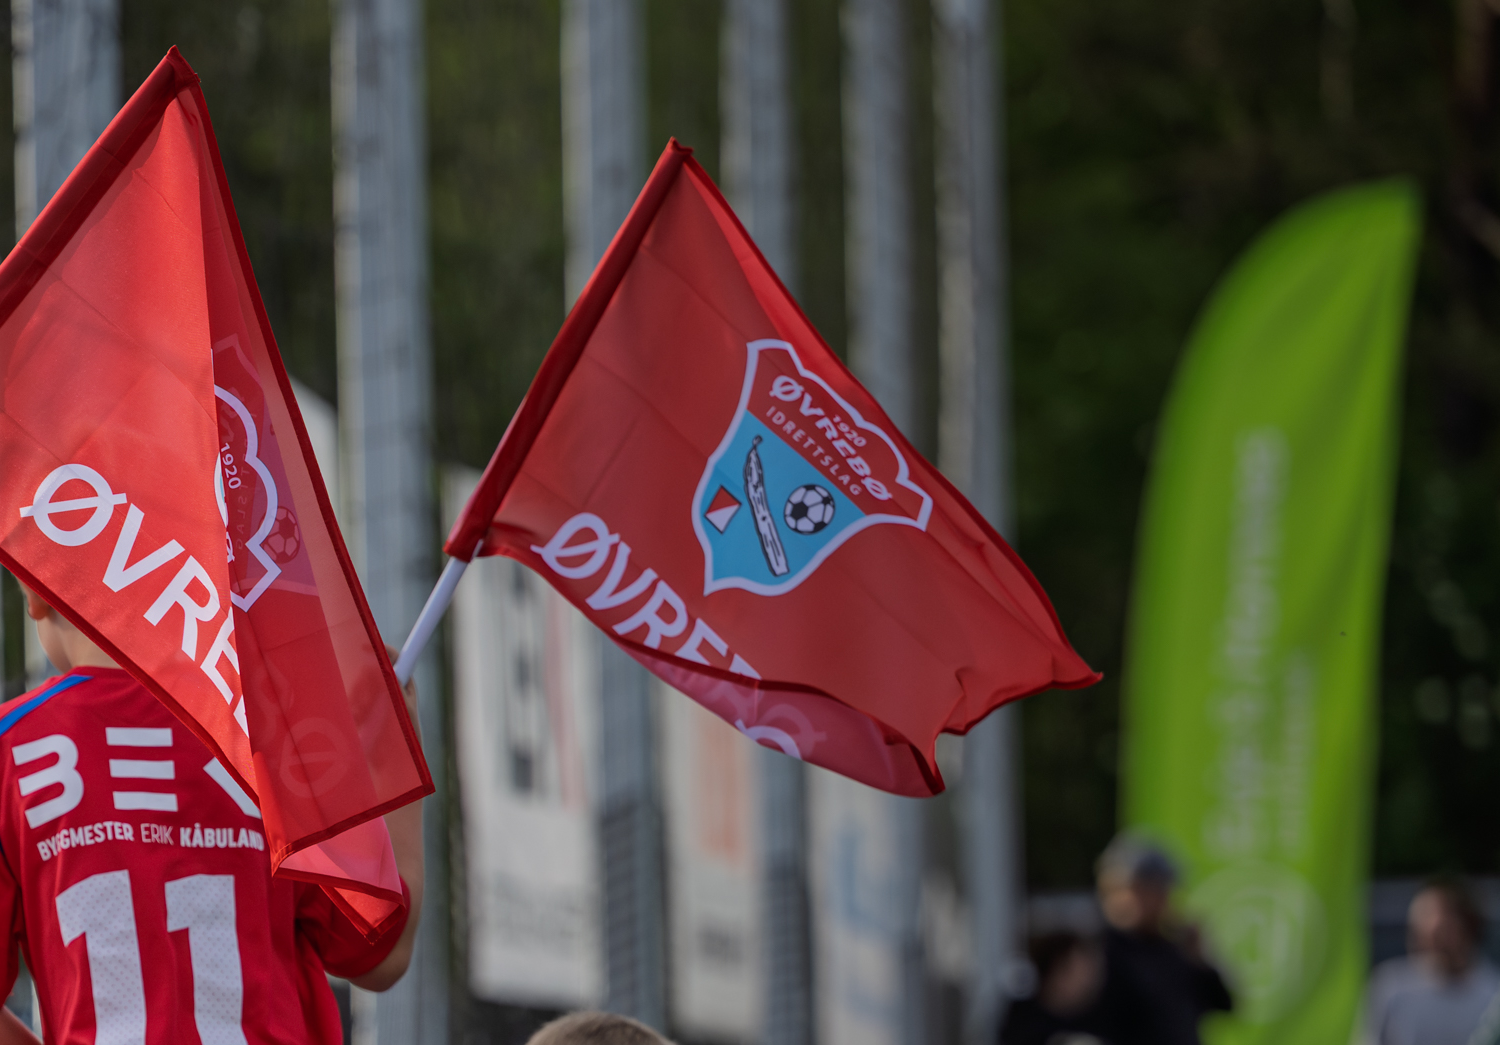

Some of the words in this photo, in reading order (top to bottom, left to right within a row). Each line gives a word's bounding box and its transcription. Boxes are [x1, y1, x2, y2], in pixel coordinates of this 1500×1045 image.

[220, 442, 242, 490] 1920
[766, 406, 862, 496] IDRETTSLAG
[769, 375, 893, 500] ØVREBØ
[833, 414, 867, 447] 1920
[19, 463, 250, 738] ØVRE
[531, 513, 761, 680] ØVRE
[37, 821, 134, 861] BYGGMESTER
[140, 823, 175, 846] ERIK
[180, 823, 265, 851] KÅBULAND
